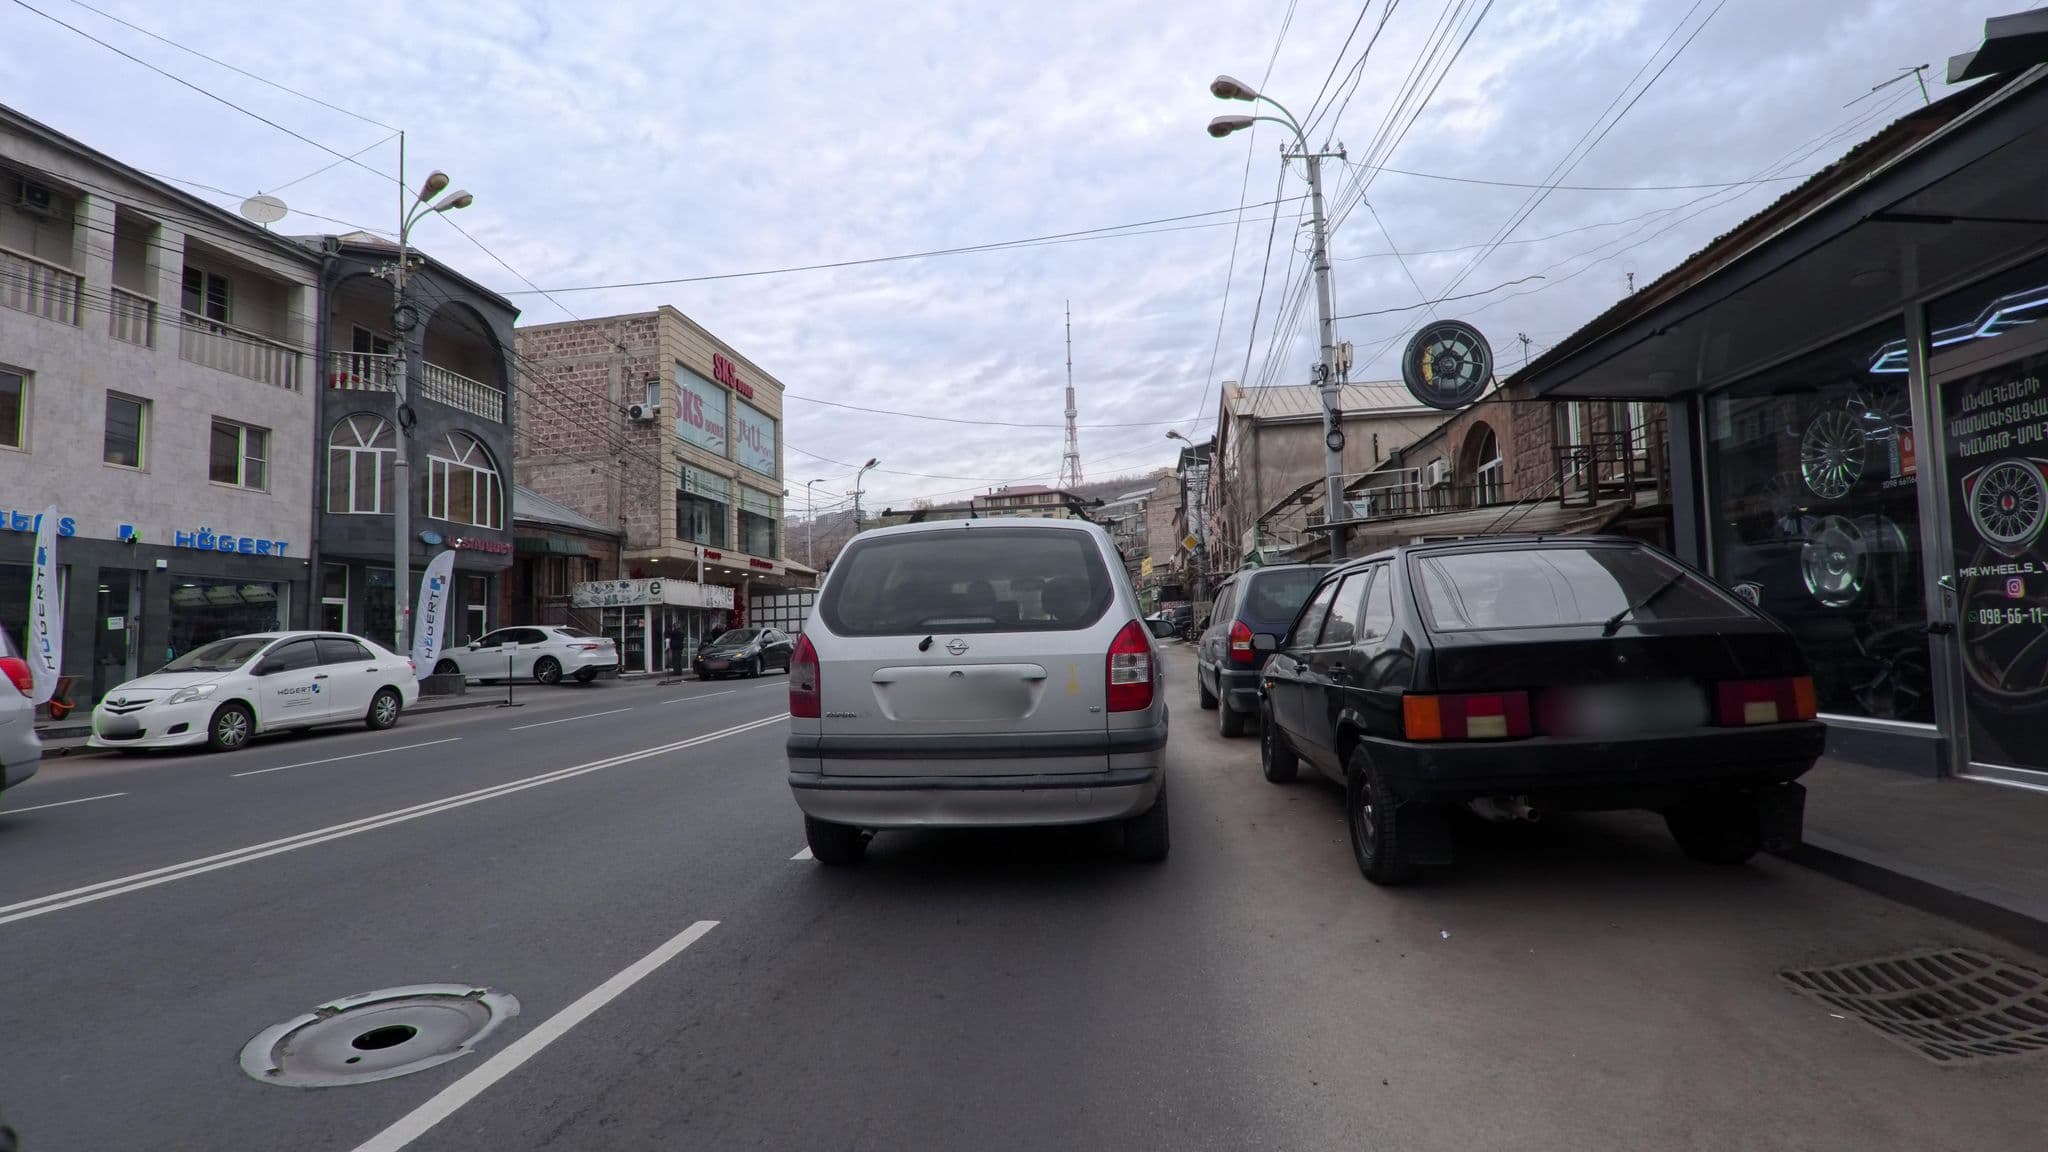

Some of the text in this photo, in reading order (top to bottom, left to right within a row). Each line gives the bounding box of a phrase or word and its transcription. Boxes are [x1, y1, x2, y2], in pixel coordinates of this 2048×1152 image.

[713, 352, 736, 389] SKS
[674, 383, 704, 429] SKS
[1951, 396, 2048, 437] ՄԱՍՆԱԳԻՏԱՑՎԱ
[175, 526, 289, 557] HÖGERT
[424, 591, 441, 659] HÖGERT
